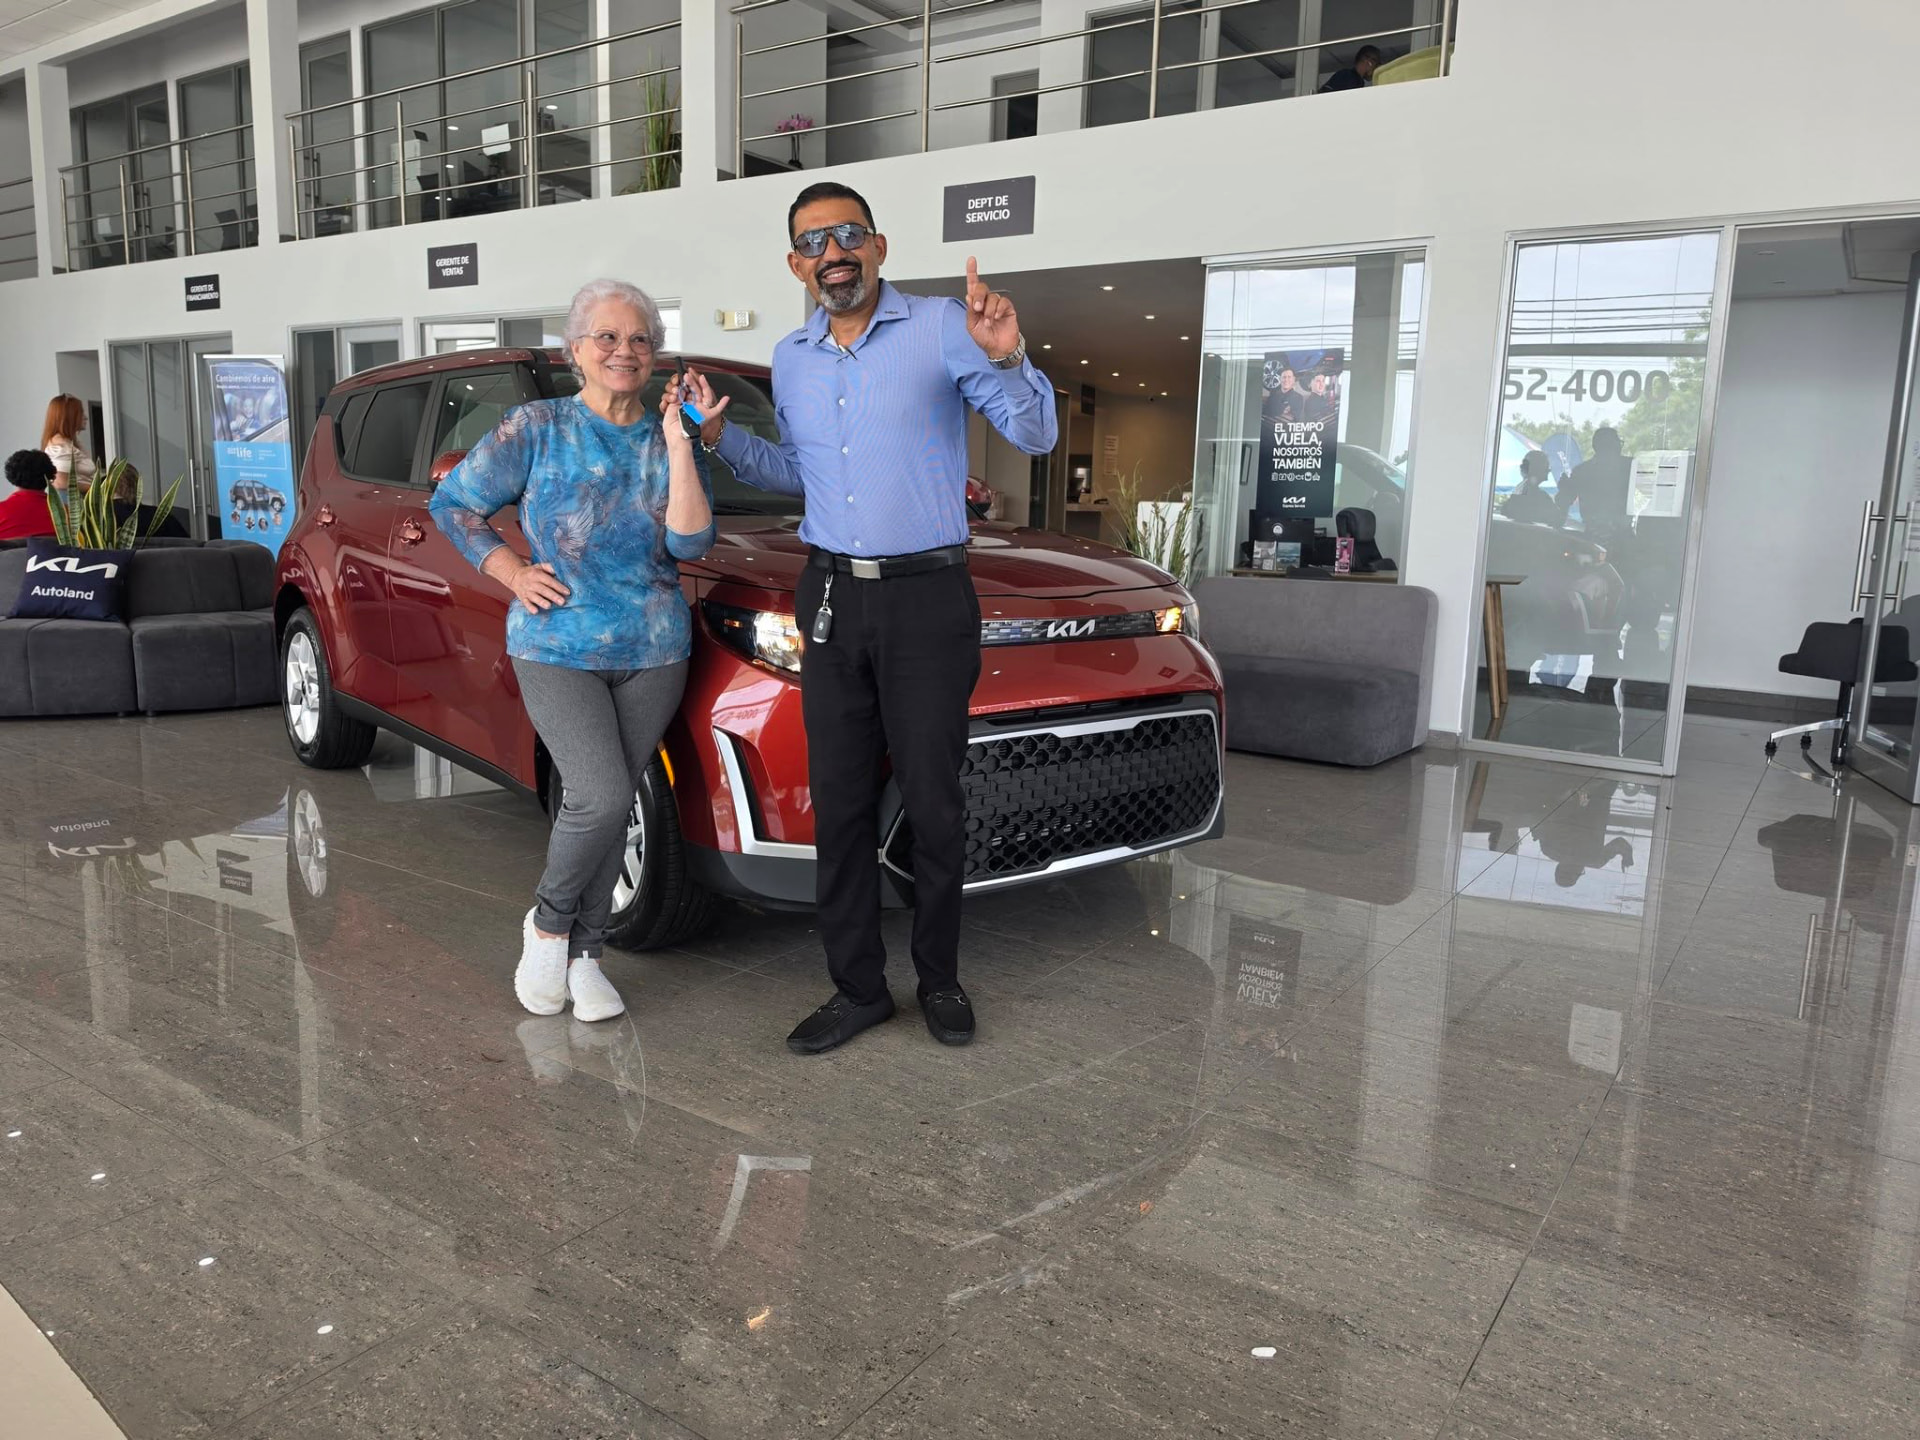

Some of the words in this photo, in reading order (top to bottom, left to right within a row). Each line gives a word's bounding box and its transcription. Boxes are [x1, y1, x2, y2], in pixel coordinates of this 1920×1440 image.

[968, 197, 994, 209] DEPT
[995, 195, 1009, 206] DE
[965, 208, 1011, 223] SERVICIO
[435, 257, 460, 267] GERENTE
[461, 255, 470, 264] DE
[441, 266, 464, 276] VENTAS
[252, 374, 261, 383] de
[262, 374, 276, 383] aire
[1274, 422, 1286, 433] EL
[1287, 421, 1324, 433] TIEMPO
[1274, 432, 1323, 447] VUELA,
[1272, 446, 1323, 457] NOSOTROS
[1272, 456, 1322, 469] TAMBIÉN
[1282, 496, 1306, 504] KIA
[26, 555, 119, 579] KIA
[31, 585, 95, 601] Autoland
[1047, 619, 1096, 638] KIA
